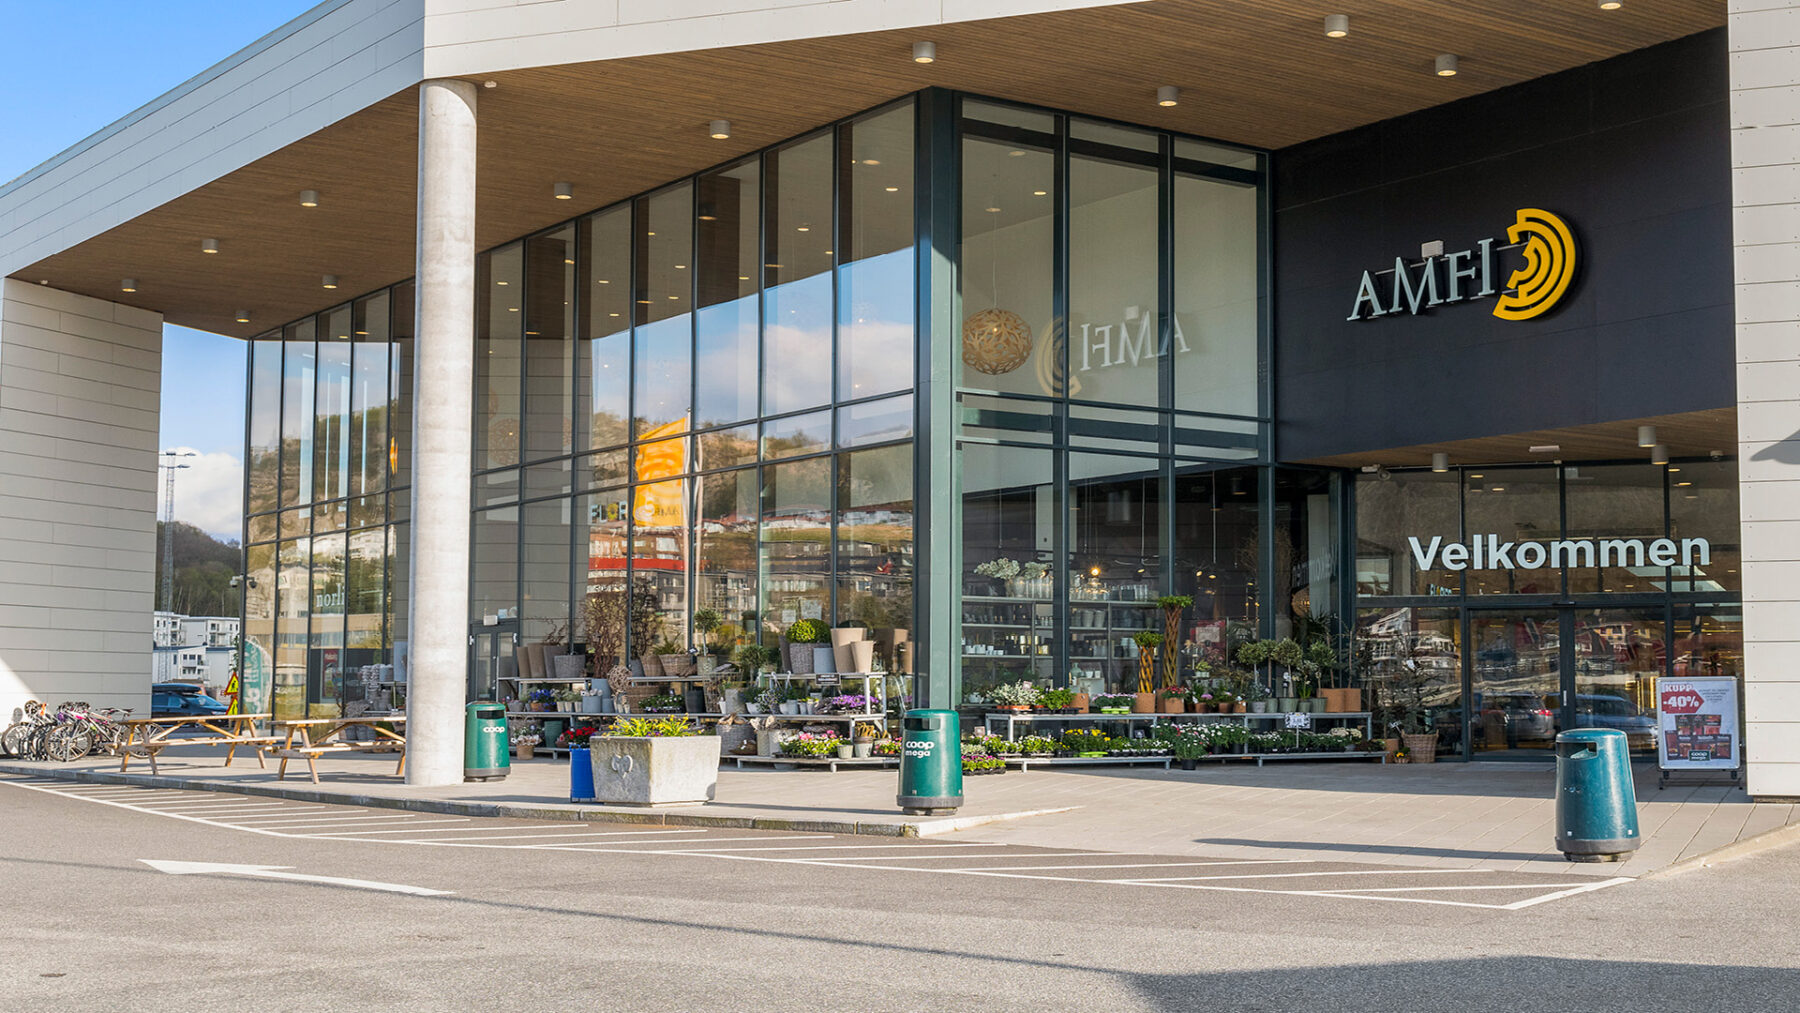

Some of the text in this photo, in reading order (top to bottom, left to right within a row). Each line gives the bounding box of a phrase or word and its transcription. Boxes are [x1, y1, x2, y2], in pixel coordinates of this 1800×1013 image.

[1347, 238, 1496, 321] AMFI
[1408, 534, 1710, 571] Velkommen
[1665, 684, 1693, 692] KUPP
[1663, 695, 1700, 707] -40%
[906, 741, 935, 750] coop
[905, 750, 931, 758] mega
